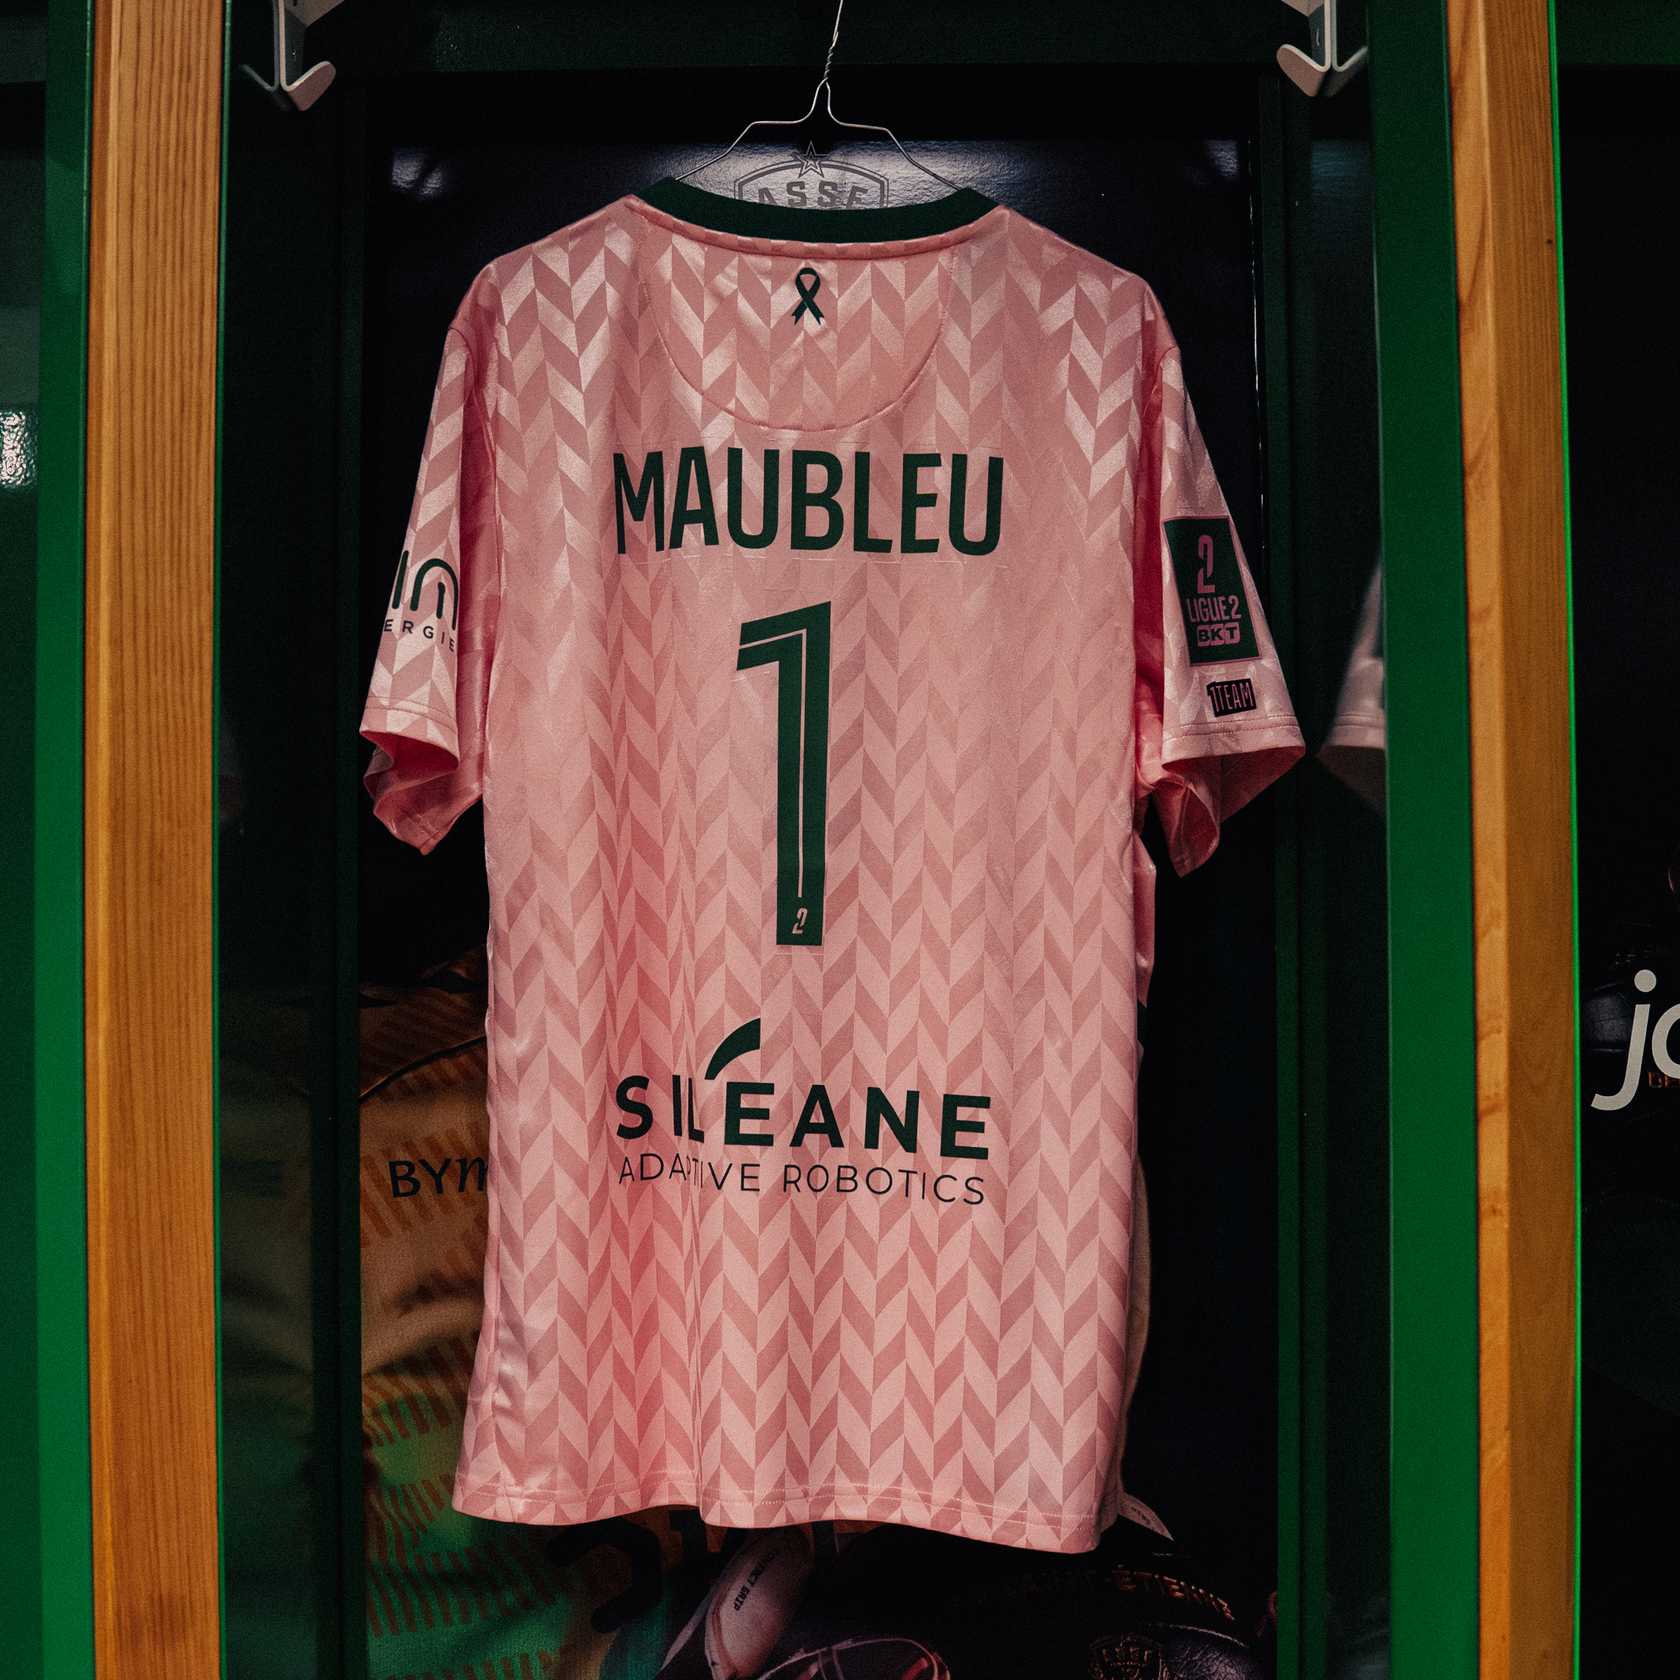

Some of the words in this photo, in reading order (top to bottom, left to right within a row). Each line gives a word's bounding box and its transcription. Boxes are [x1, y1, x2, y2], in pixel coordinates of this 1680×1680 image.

[758, 181, 868, 209] ASSE
[613, 446, 1005, 556] MAUBLEU
[1199, 626, 1239, 645] BKT
[736, 601, 831, 946] 1
[783, 1164, 985, 1206] ROBOTICS
